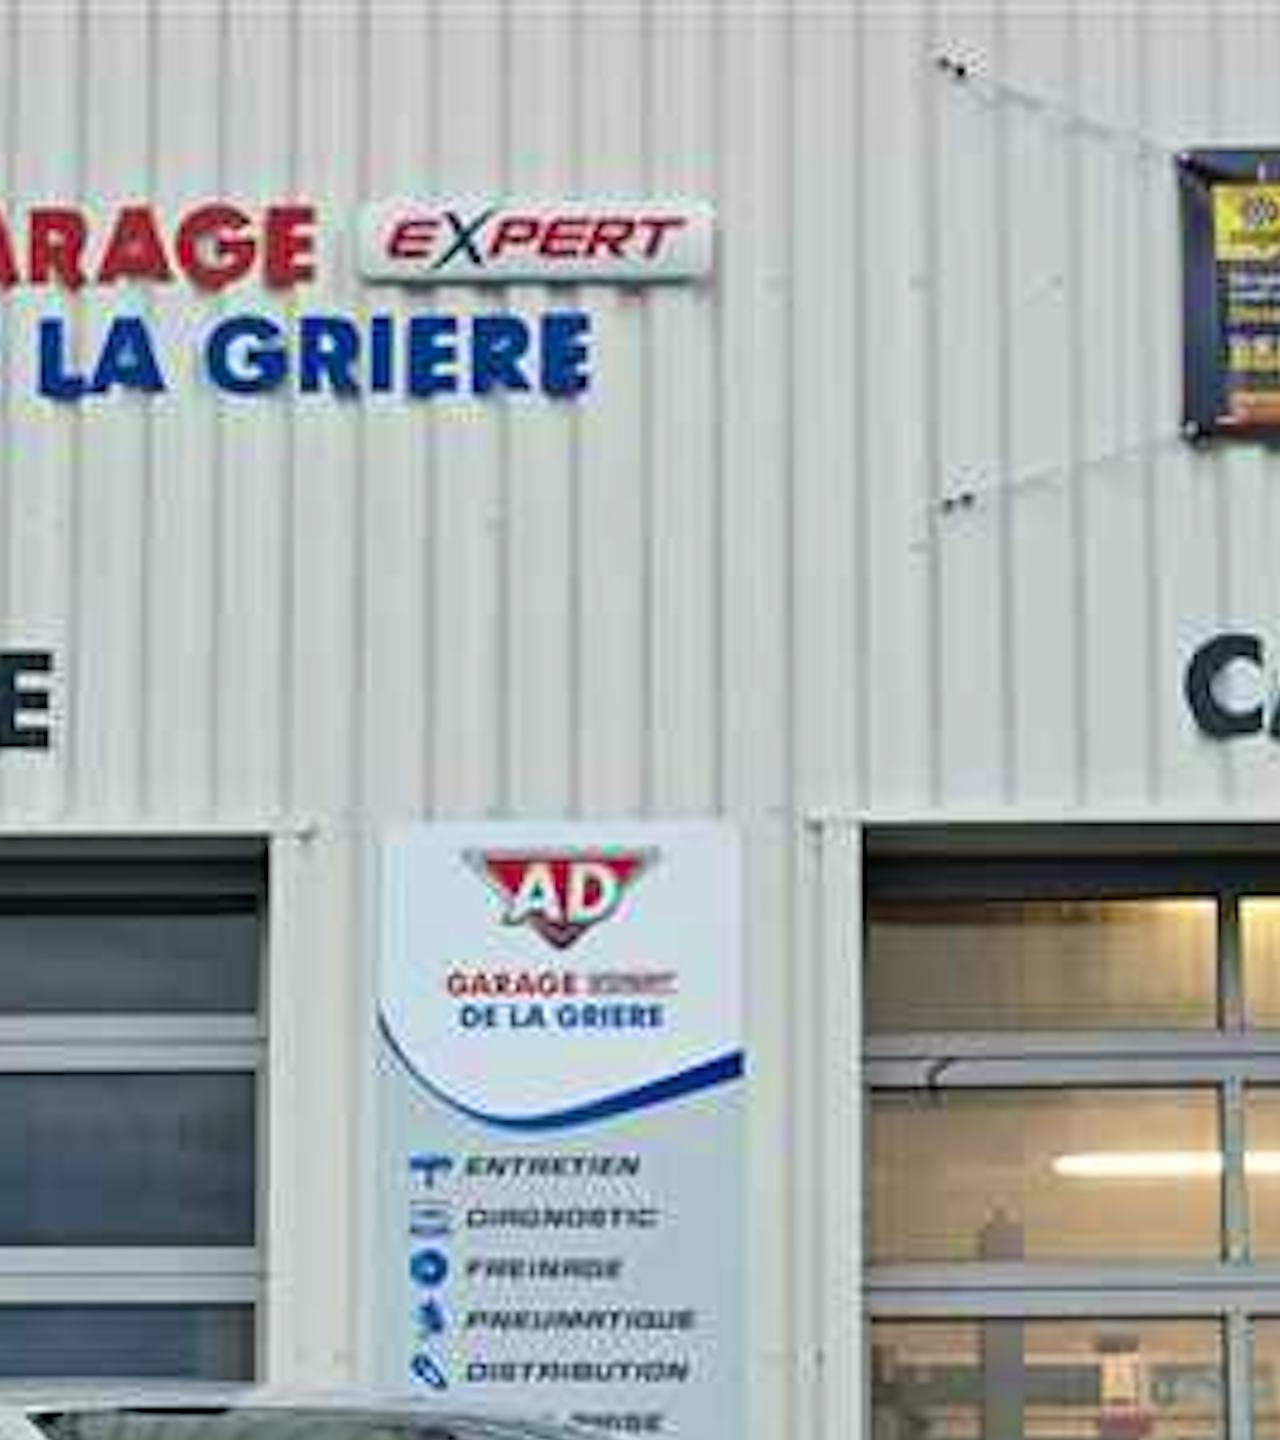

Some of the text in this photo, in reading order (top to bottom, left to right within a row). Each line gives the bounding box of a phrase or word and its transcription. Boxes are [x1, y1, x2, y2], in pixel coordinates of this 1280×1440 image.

[37, 315, 166, 402] LA
[205, 313, 591, 399] GRIERE
[504, 858, 622, 925] AD
[446, 971, 576, 998] GARAGE
[459, 1003, 665, 1029] DE LA GRIERE
[463, 1156, 642, 1177] ENTRETIEN
[464, 1309, 697, 1331] PNEUMATIQUE
[464, 1360, 691, 1383] DISTRIBUTION
